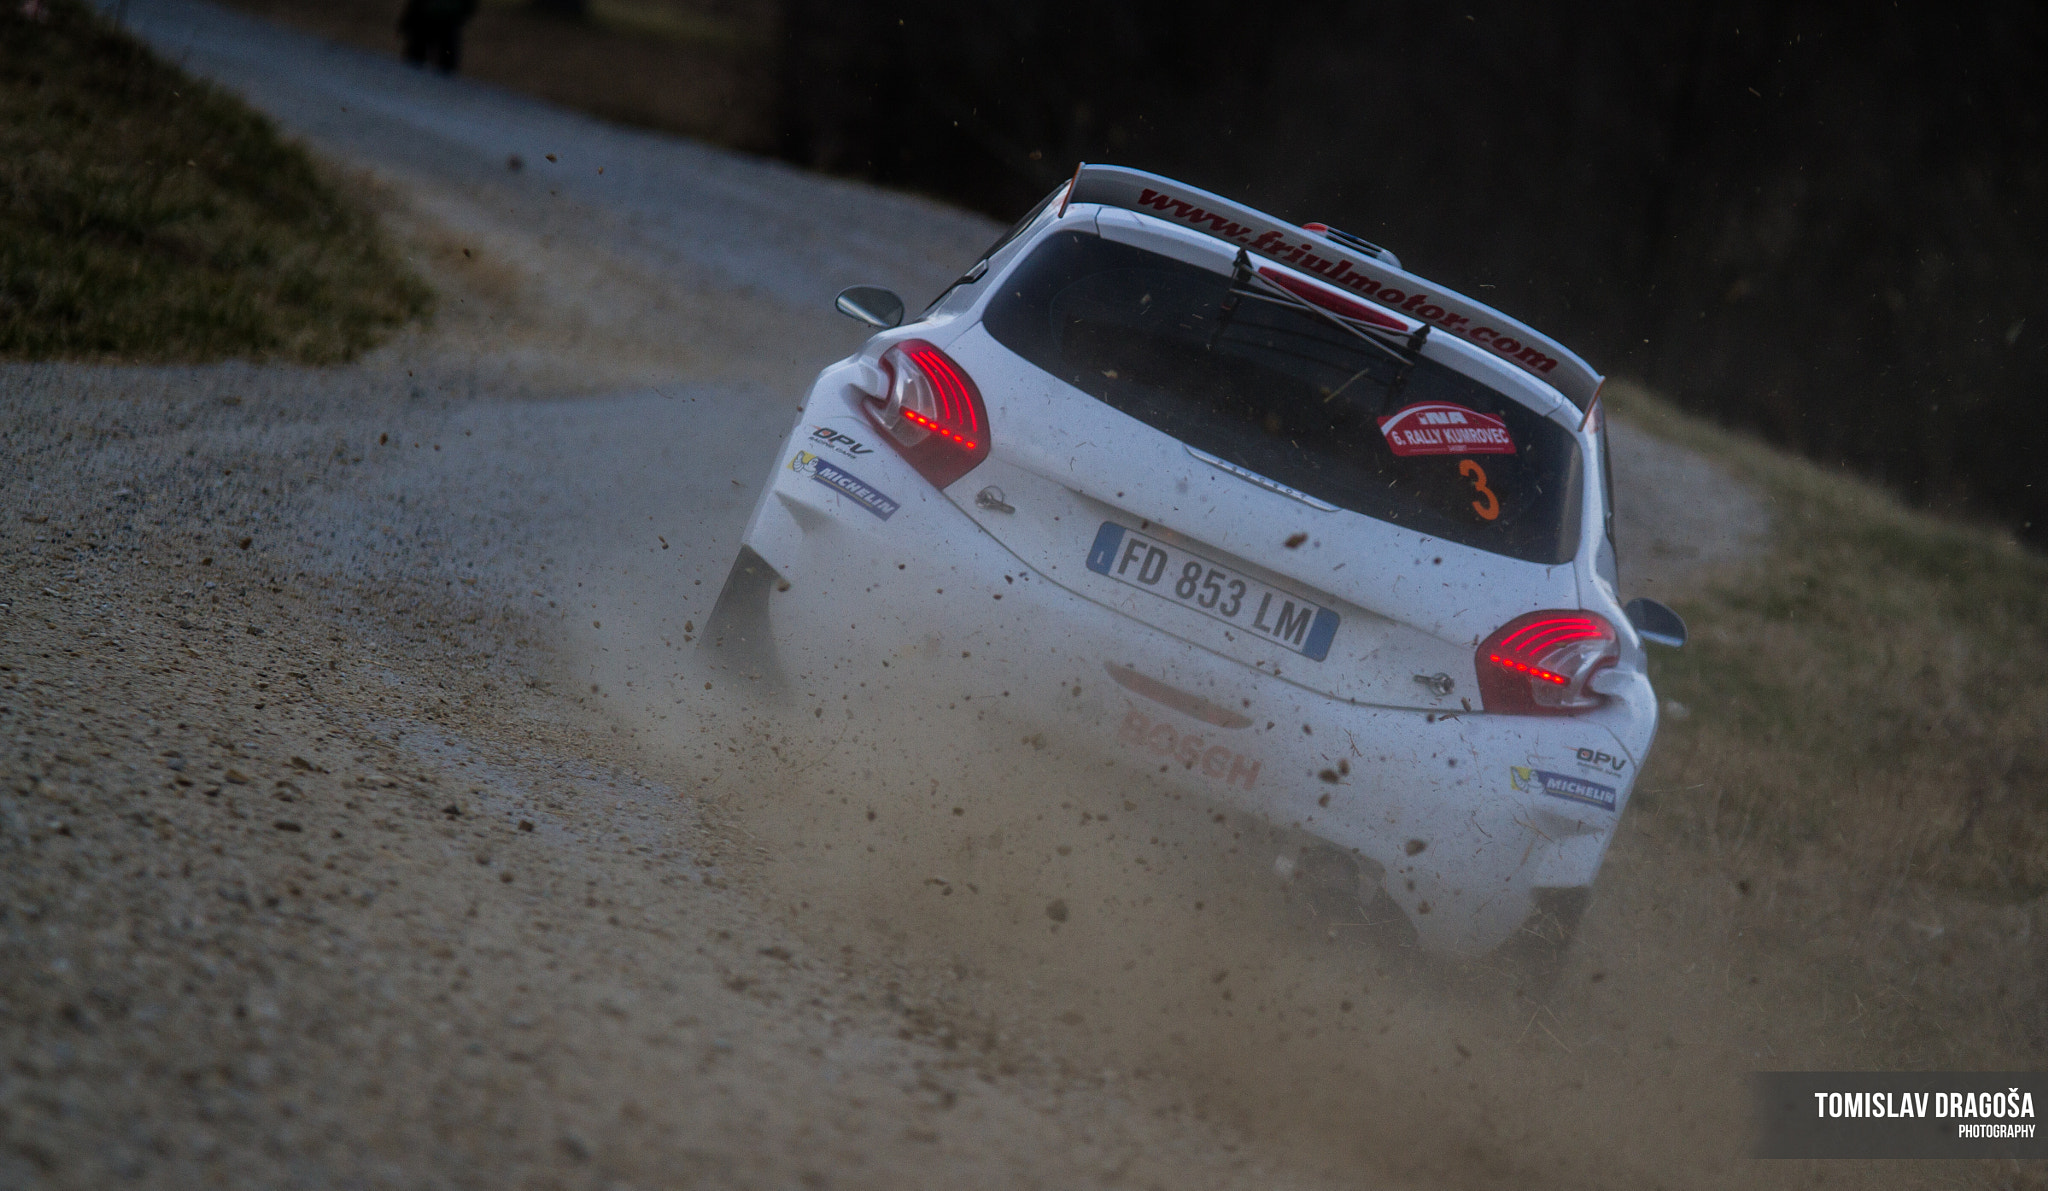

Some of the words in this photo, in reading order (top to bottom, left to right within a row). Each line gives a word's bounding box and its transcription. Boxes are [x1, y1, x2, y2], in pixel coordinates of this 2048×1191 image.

[1137, 188, 1558, 373] www.friulmotor.com
[812, 427, 874, 454] OPV
[1391, 430, 1407, 446] 6.
[1406, 428, 1443, 445] RALLY
[1443, 427, 1510, 445] KUMROVEC
[819, 467, 896, 514] MICHELIN
[1459, 459, 1500, 521] 3
[1117, 538, 1168, 585] FD
[1175, 561, 1247, 617] 853
[1253, 592, 1313, 646] LM
[1117, 711, 1262, 791] BOSCH
[1576, 747, 1627, 771] OPV
[1546, 778, 1615, 804] MICHELIN
